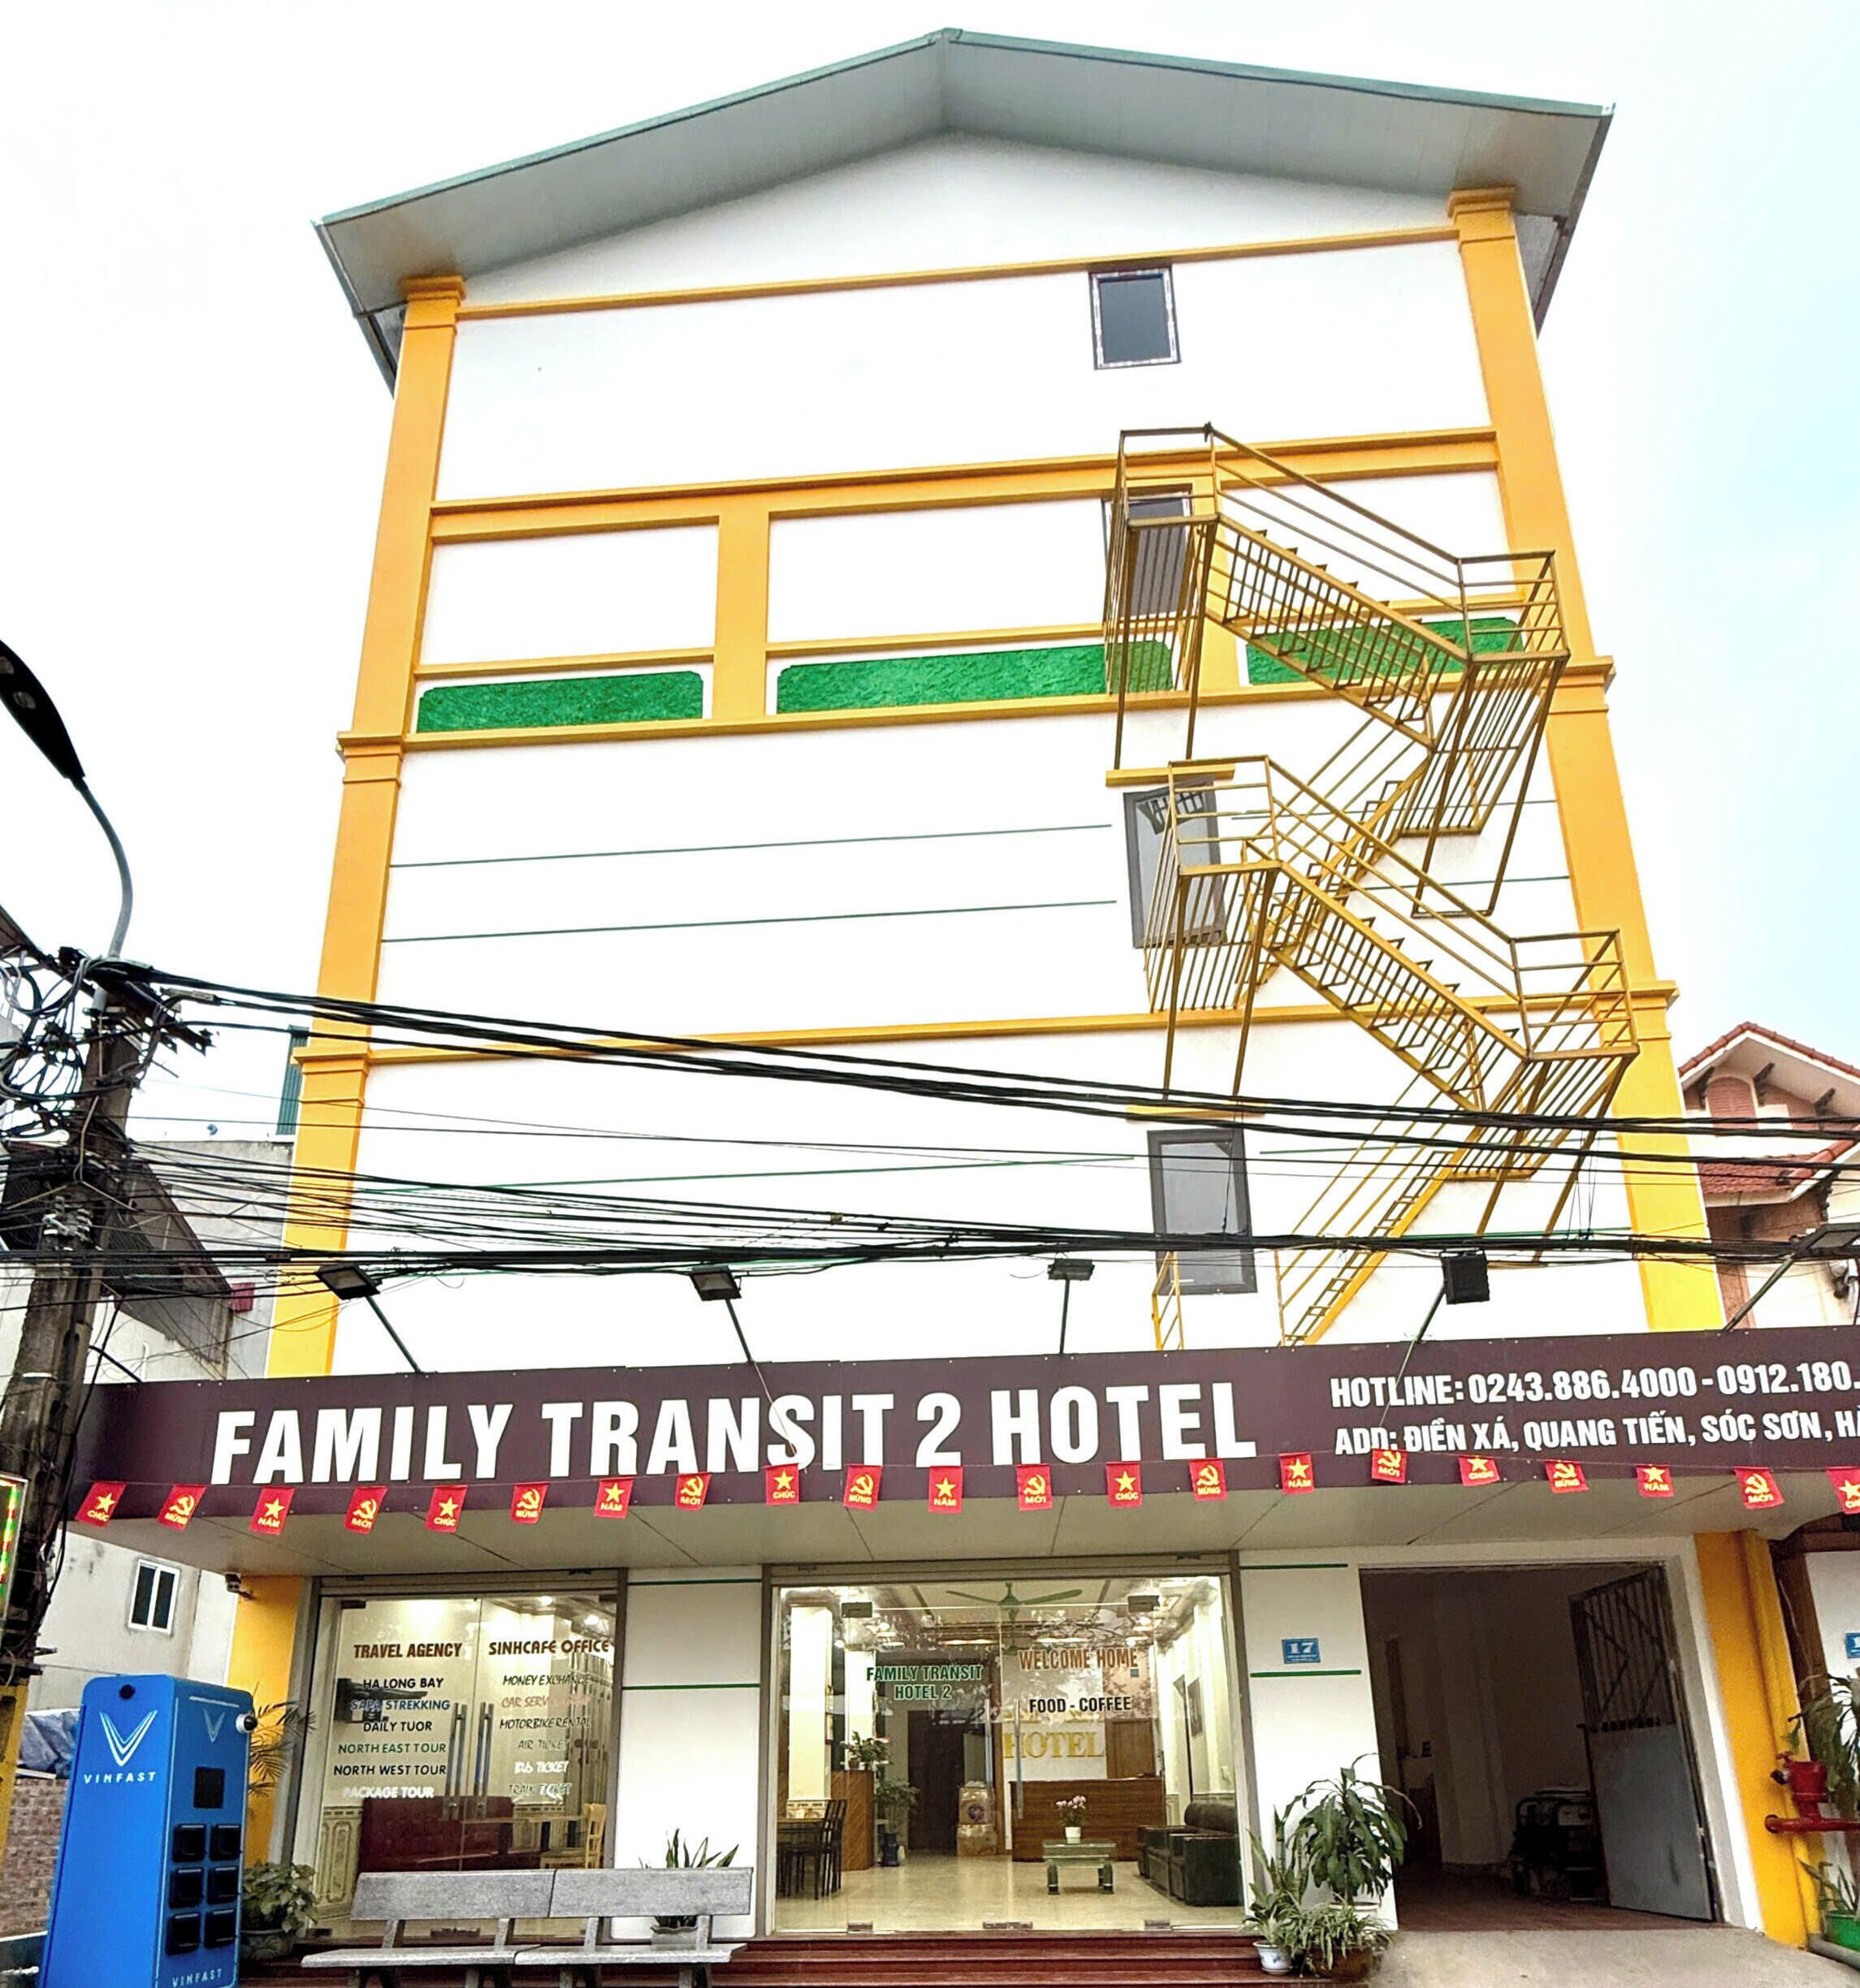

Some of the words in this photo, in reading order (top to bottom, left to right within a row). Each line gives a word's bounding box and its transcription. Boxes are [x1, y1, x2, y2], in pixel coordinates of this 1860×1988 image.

[1330, 1375, 1464, 1407] HOTLINE:
[1468, 1367, 1698, 1403] 0243.886.4000
[210, 1403, 513, 1485] FAMILY
[542, 1393, 893, 1478] TRANSIT
[915, 1391, 962, 1468] 2
[990, 1382, 1257, 1465] HOTEL
[1334, 1427, 1398, 1454] ADD:
[1404, 1417, 1467, 1452] ĐIỀN
[1471, 1415, 1519, 1452] XÁ,
[1523, 1419, 1617, 1451] QUANG
[1623, 1410, 1696, 1446] TIẾN,
[1700, 1408, 1757, 1442] SÓC
[1762, 1411, 1833, 1441] SƠN,
[1834, 1405, 1860, 1437] H
[353, 1644, 403, 1658] TRAVEL
[406, 1643, 463, 1657] AGENCY
[488, 1640, 556, 1655] SINHCAFE
[560, 1640, 609, 1653] OFFICE
[1287, 1642, 1314, 1653] 17
[1019, 1649, 1091, 1670] WELCOME
[1097, 1648, 1139, 1668] HOME
[866, 1666, 918, 1682] FAMILY
[923, 1665, 984, 1681] TRANSIT
[363, 1679, 379, 1688] HA
[383, 1678, 416, 1688] LONG
[419, 1677, 443, 1688] BAY
[502, 1675, 539, 1686] MONEY
[894, 1684, 939, 1700] HOTEL
[941, 1684, 952, 1700] 2
[385, 1700, 451, 1710] STREKKING
[501, 1697, 521, 1708] CAR
[1029, 1698, 1066, 1714] FOOD
[1079, 1696, 1132, 1712] COFFEE
[363, 1722, 397, 1732] DAILY
[400, 1721, 432, 1731] TUOR
[338, 1744, 379, 1754] NORTH
[382, 1744, 410, 1753] EAST
[413, 1743, 447, 1753] TOUR
[518, 1740, 534, 1750] AIR
[537, 1739, 569, 1749] TICKET
[1003, 1731, 1105, 1758] HOTEL
[334, 1765, 375, 1775] NORTH
[379, 1765, 412, 1775] WEST
[414, 1765, 447, 1775] TOUR
[536, 1761, 569, 1773] TICKET
[84, 1771, 156, 1784] VINFAST
[343, 1787, 398, 1799] PACKAGE
[401, 1787, 435, 1798] TOUR
[171, 1968, 223, 1987] VINFAST
